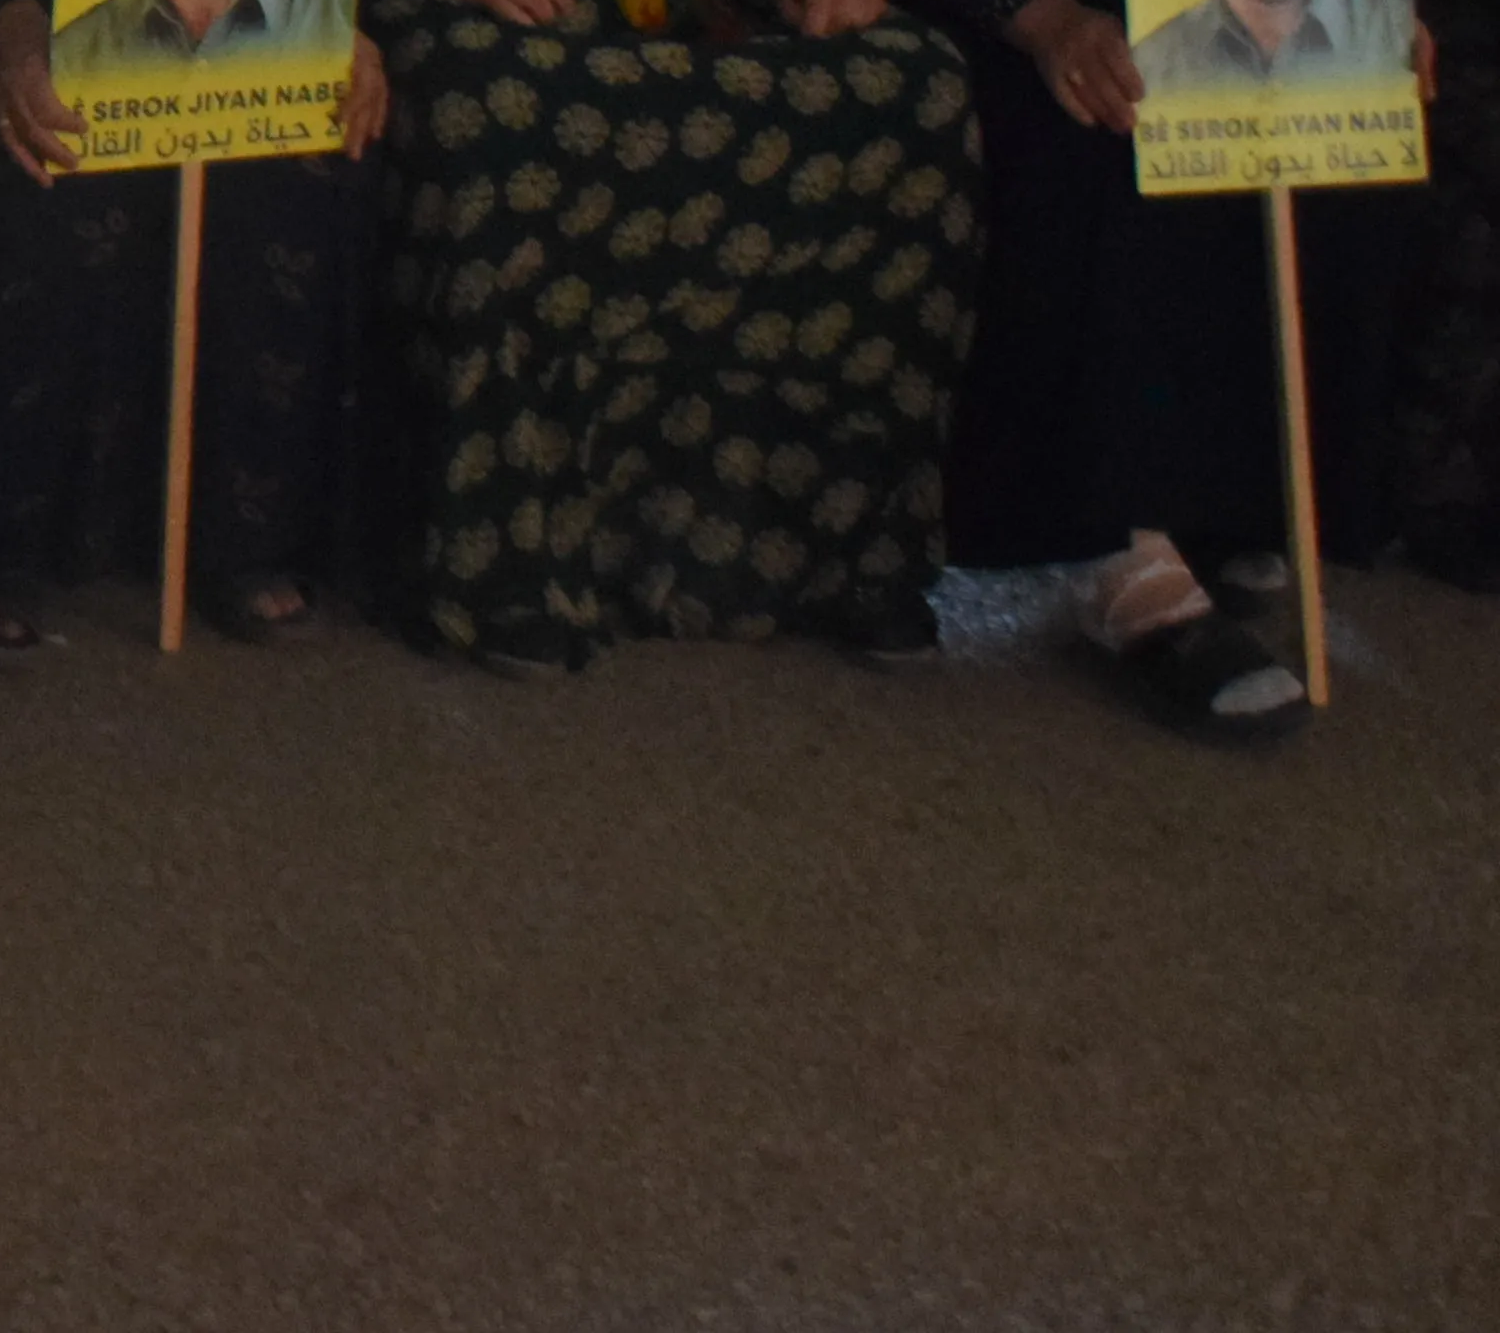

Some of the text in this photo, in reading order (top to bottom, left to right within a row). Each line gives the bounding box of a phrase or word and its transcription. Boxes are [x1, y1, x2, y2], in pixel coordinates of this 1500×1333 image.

[92, 96, 180, 123] SEROK
[188, 87, 267, 113] JIYAN
[275, 81, 346, 105] NABE
[245, 117, 312, 150] حياة
[1141, 108, 1415, 142] BÊ SEROK JIYAN NABE
[155, 128, 233, 158] بدون
[1145, 140, 1419, 182] لا حياة بدون القائد
